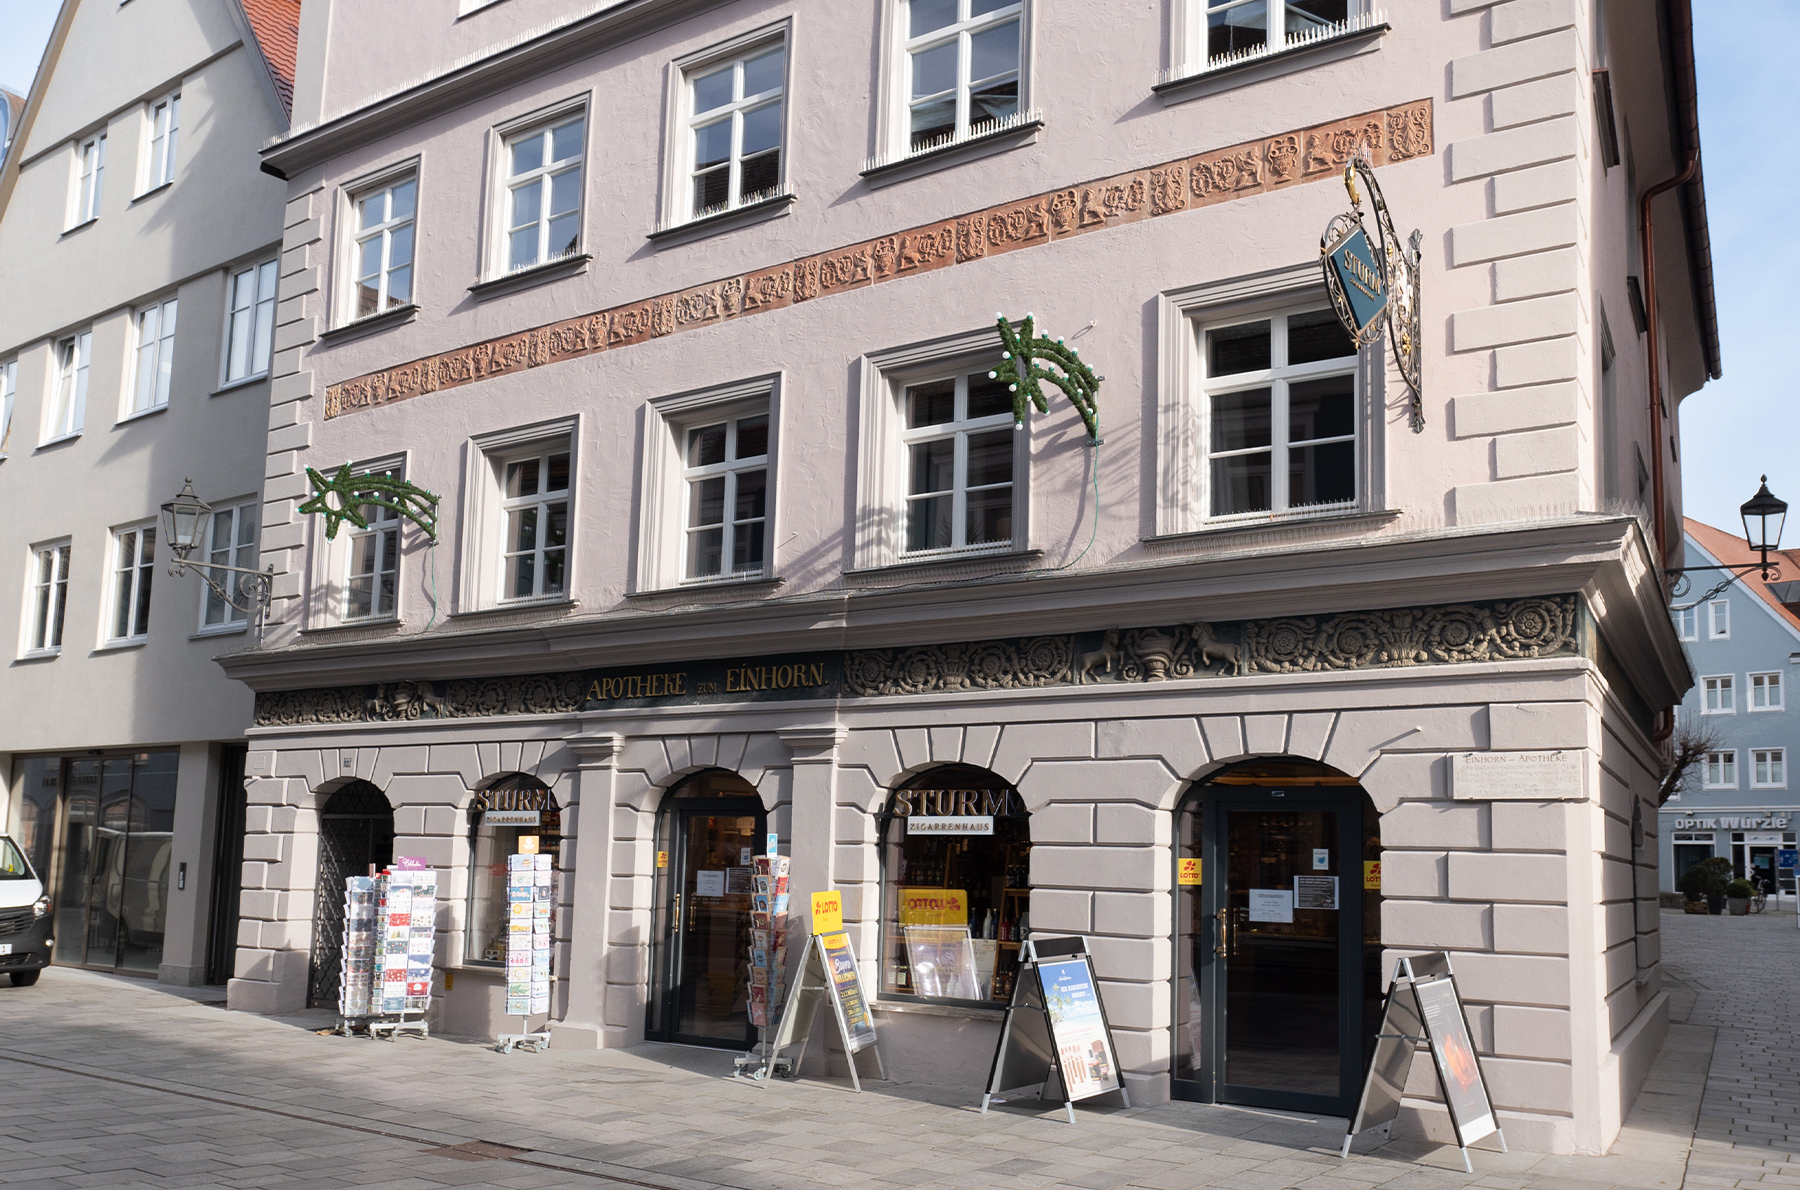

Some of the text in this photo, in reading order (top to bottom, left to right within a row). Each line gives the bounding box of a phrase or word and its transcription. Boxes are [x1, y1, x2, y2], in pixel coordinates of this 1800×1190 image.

[1344, 249, 1381, 296] STURM
[586, 672, 687, 700] APOTHEKE
[697, 682, 717, 694] ZUM
[1465, 756, 1506, 764] EINHORN
[1517, 754, 1568, 763] APOTHEKE
[476, 788, 552, 811] STURM
[894, 789, 1010, 817] STURM
[909, 822, 990, 831] ZIGARRENHAUS
[1674, 817, 1788, 830] OPTIK Würzle
[821, 900, 838, 914] LOTTO
